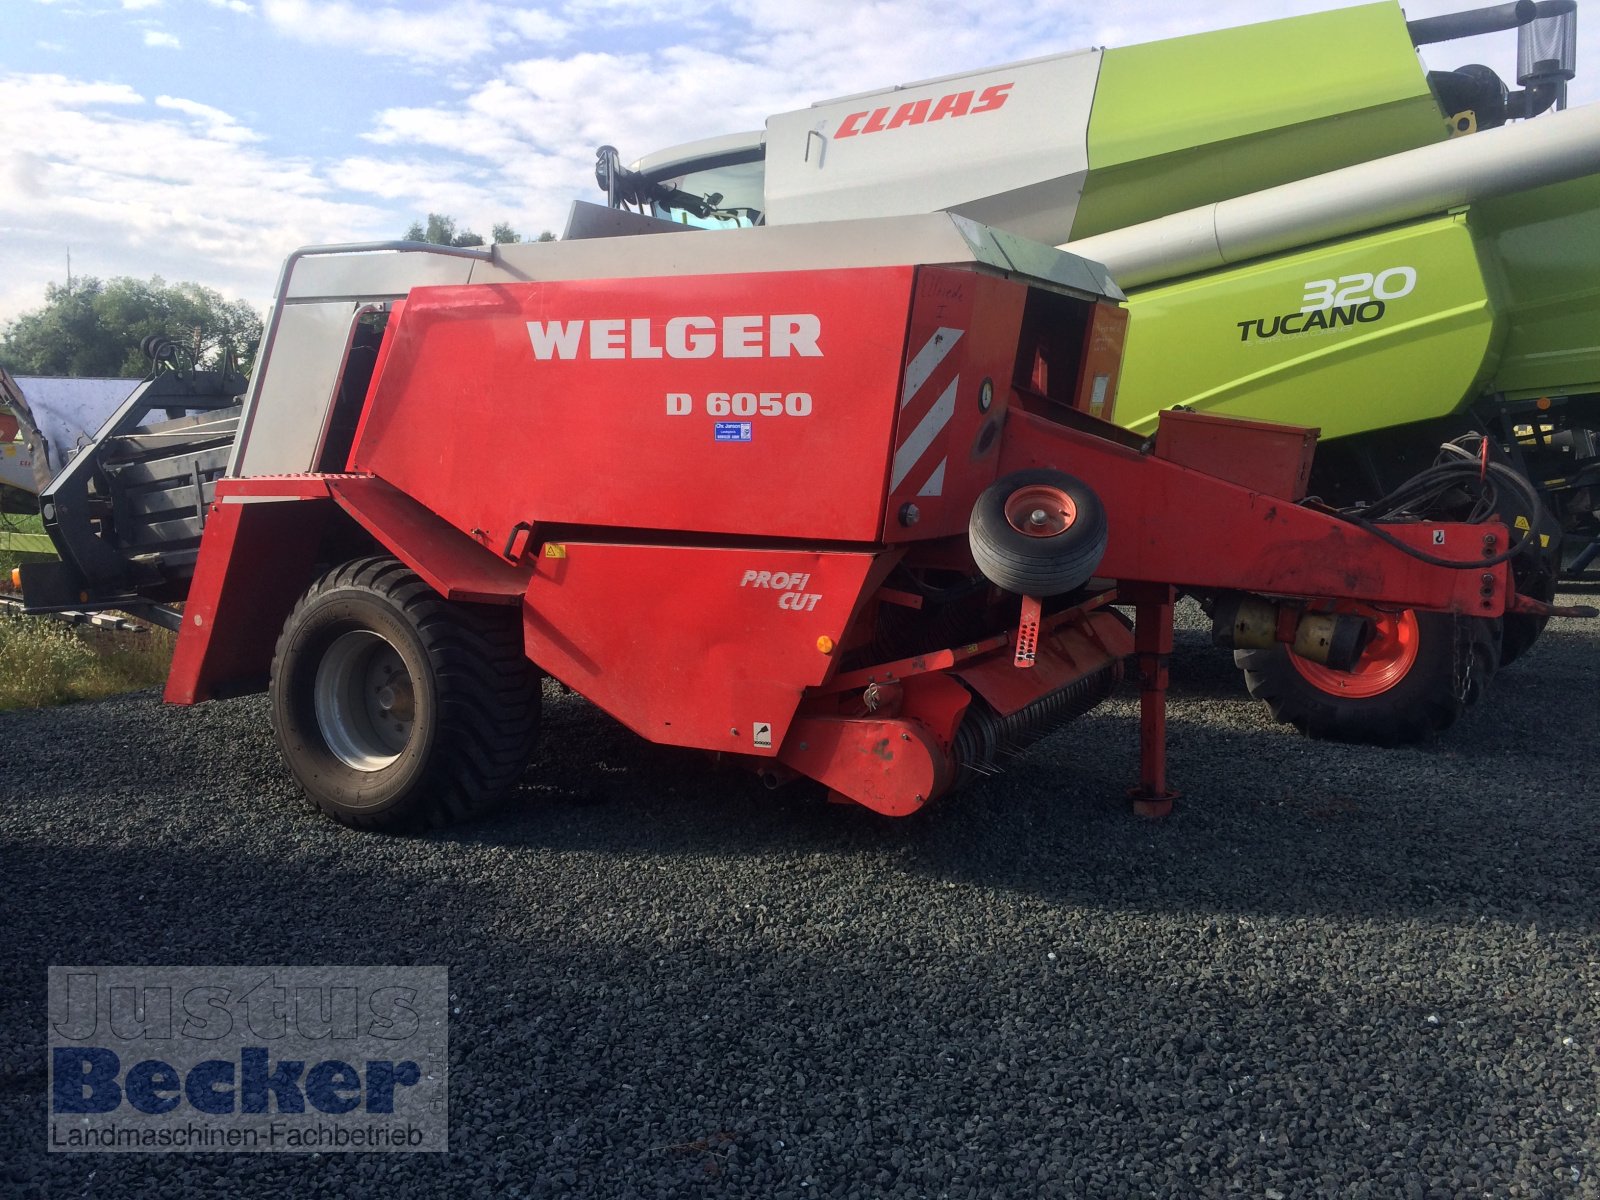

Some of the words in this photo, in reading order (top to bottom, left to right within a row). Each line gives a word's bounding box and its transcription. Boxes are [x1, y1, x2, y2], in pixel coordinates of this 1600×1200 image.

[833, 82, 1015, 139] CLAAS
[1300, 266, 1417, 313] 320
[525, 313, 824, 361] WELGER
[1237, 300, 1385, 341] TUCANO
[666, 393, 692, 416] D
[706, 392, 813, 417] 6050
[740, 569, 810, 590] PROFI
[778, 592, 822, 611] CUT
